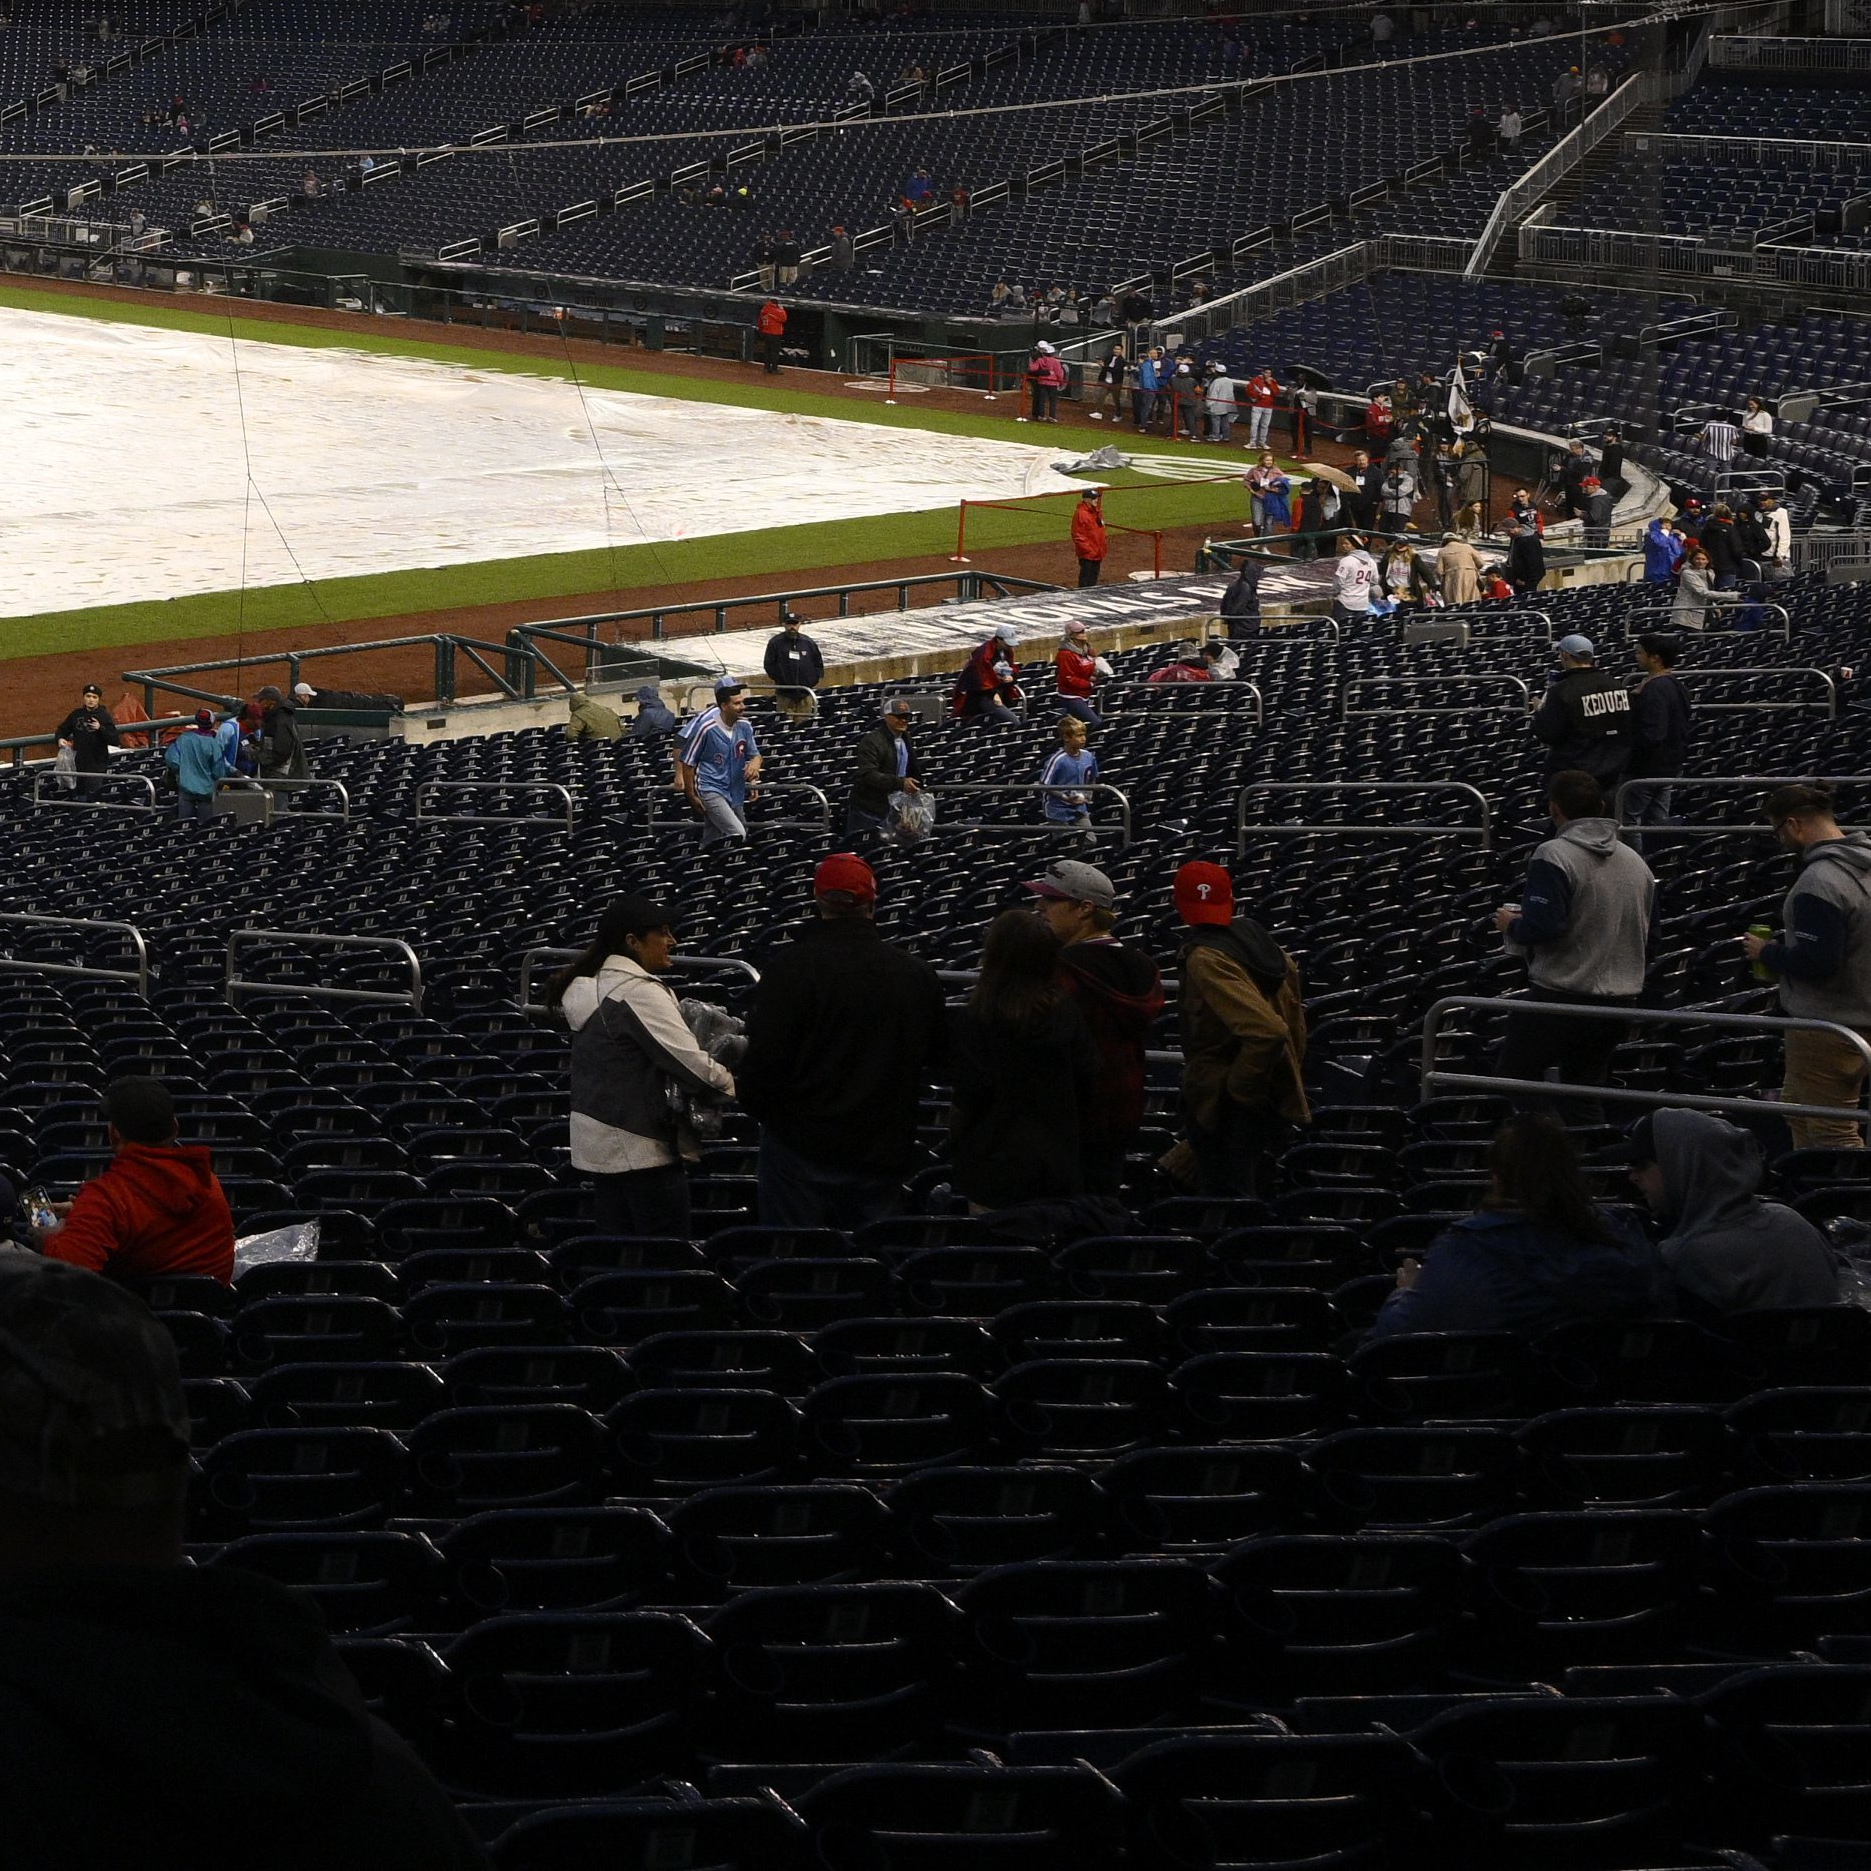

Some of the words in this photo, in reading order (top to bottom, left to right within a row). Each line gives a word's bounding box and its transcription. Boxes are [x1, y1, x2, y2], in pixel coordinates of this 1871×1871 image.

[1356, 570, 1372, 585] 24
[1580, 689, 1631, 717] KEOUGH
[1197, 883, 1212, 900] P
